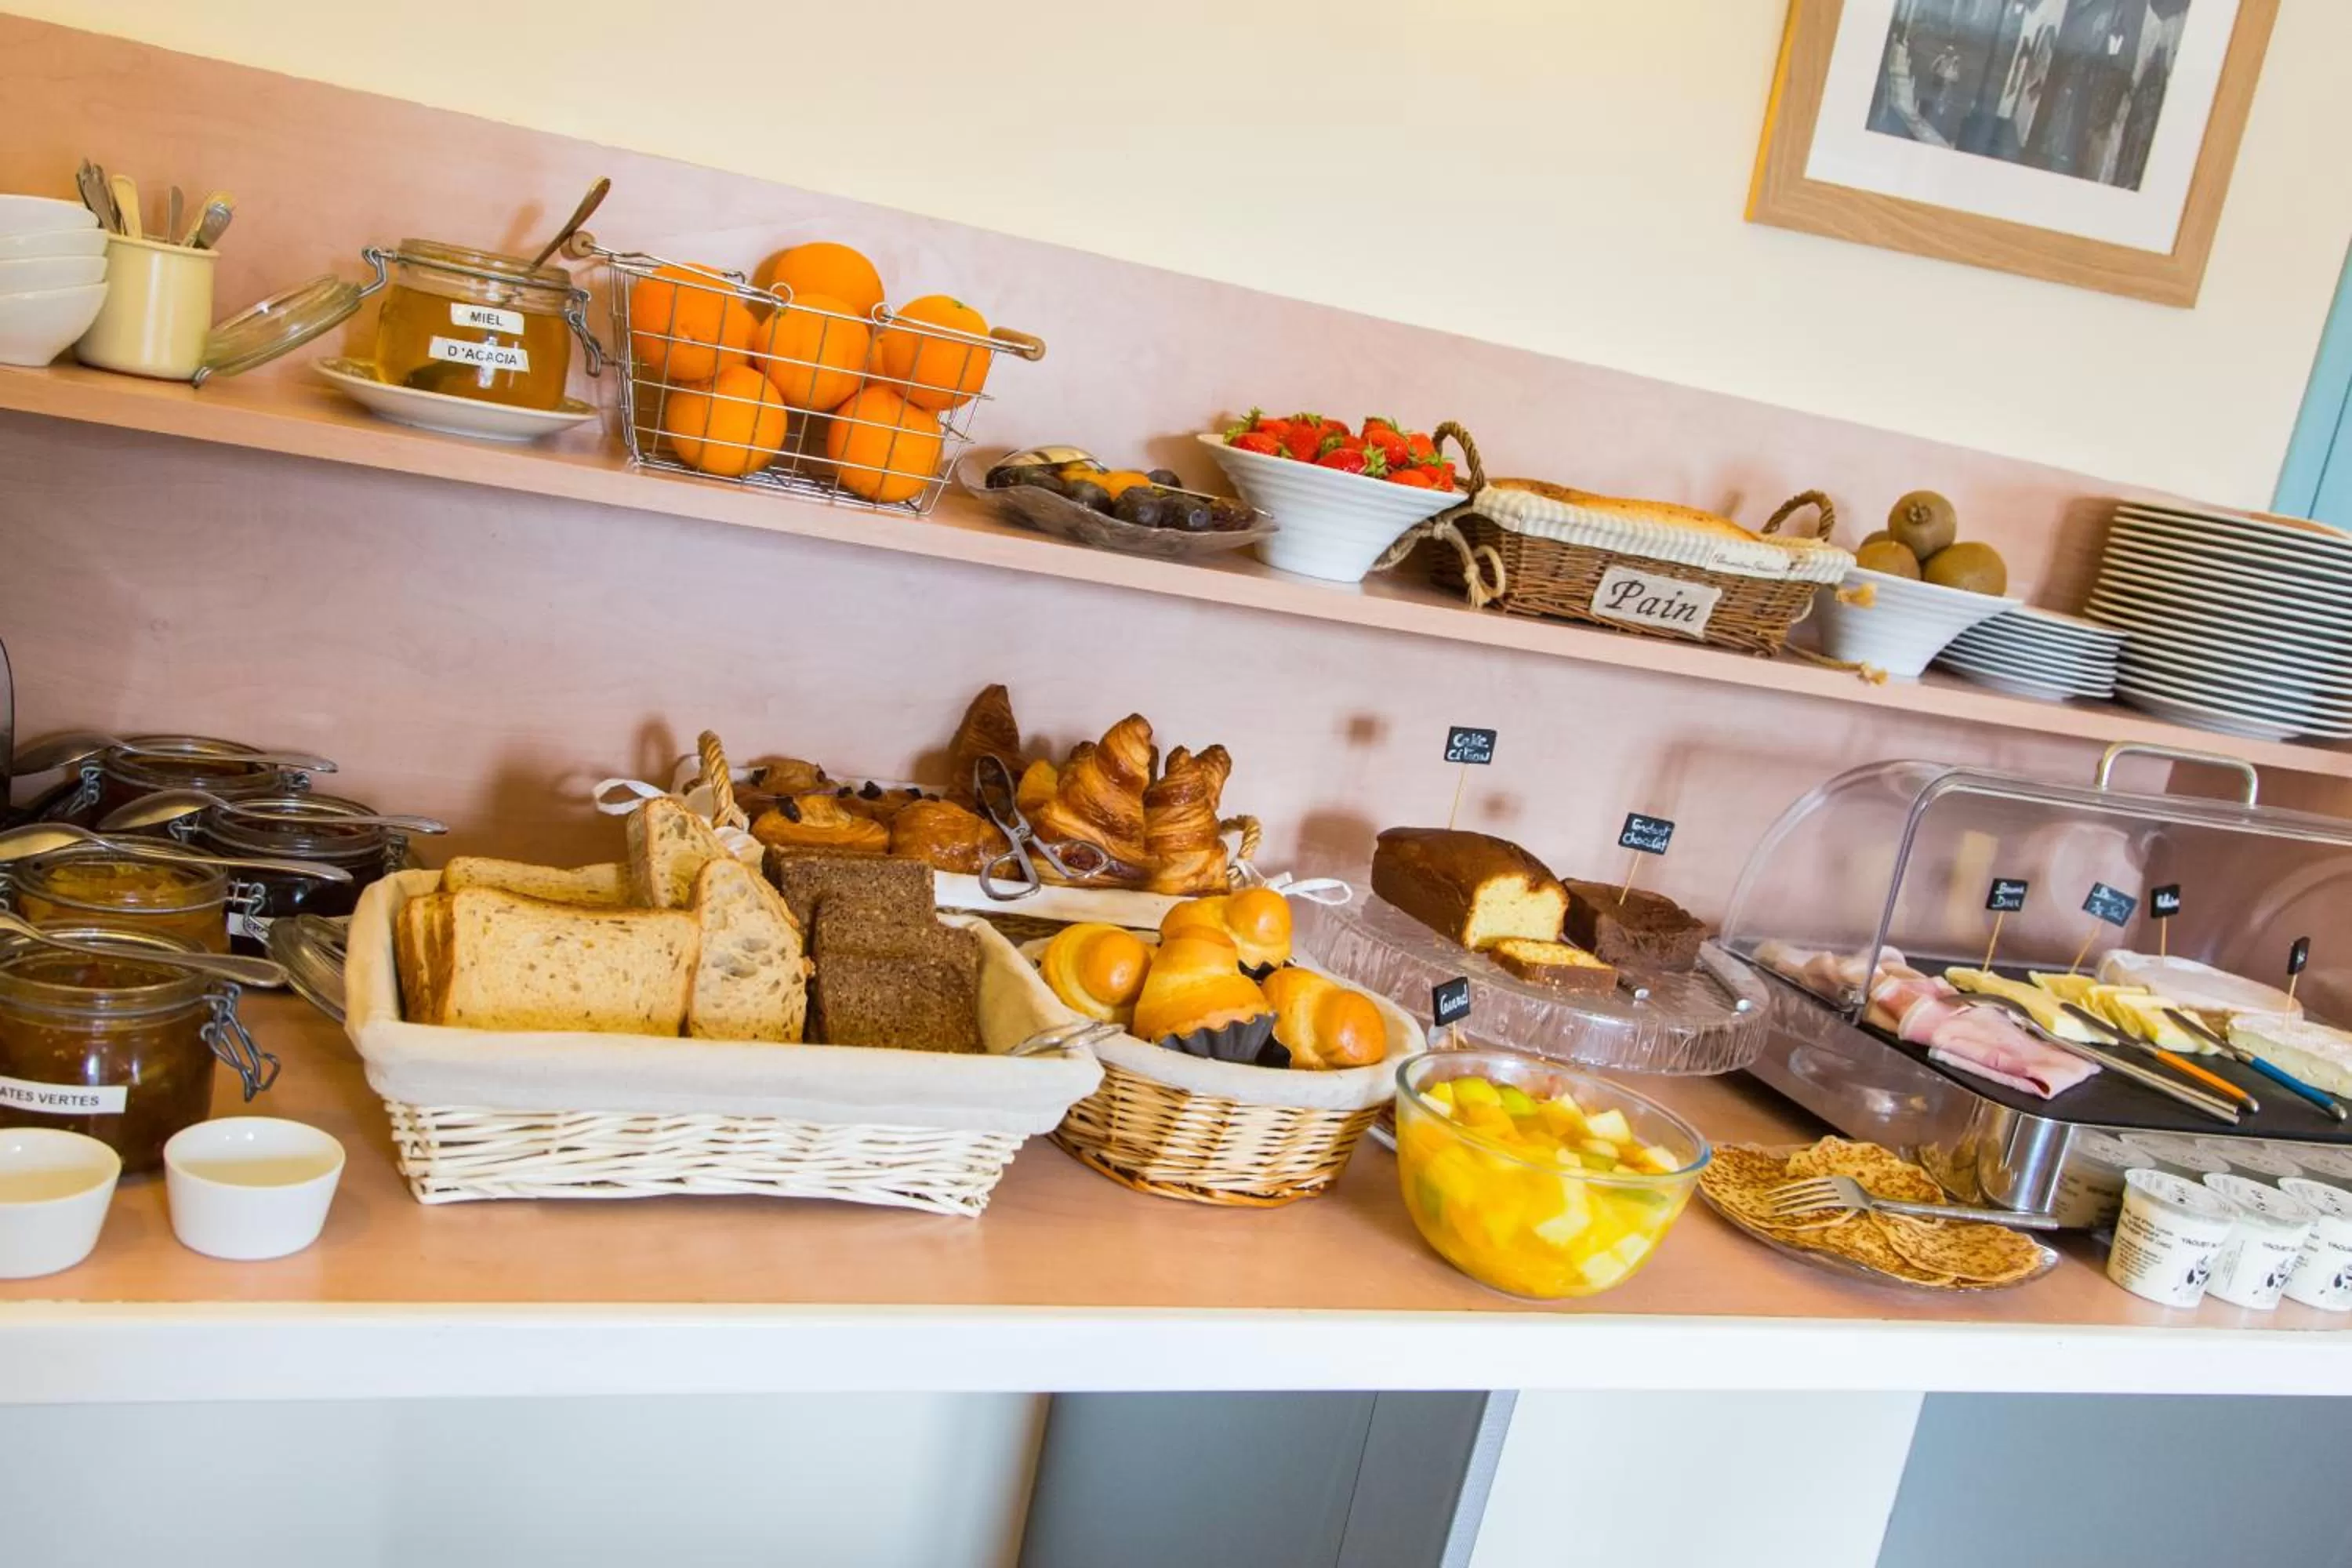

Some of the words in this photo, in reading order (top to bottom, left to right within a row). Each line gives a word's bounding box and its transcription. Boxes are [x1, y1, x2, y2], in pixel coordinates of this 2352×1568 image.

[470, 310, 503, 327] MIEL
[1605, 579, 1700, 623] Pain
[38, 1092, 100, 1107] VERTES
